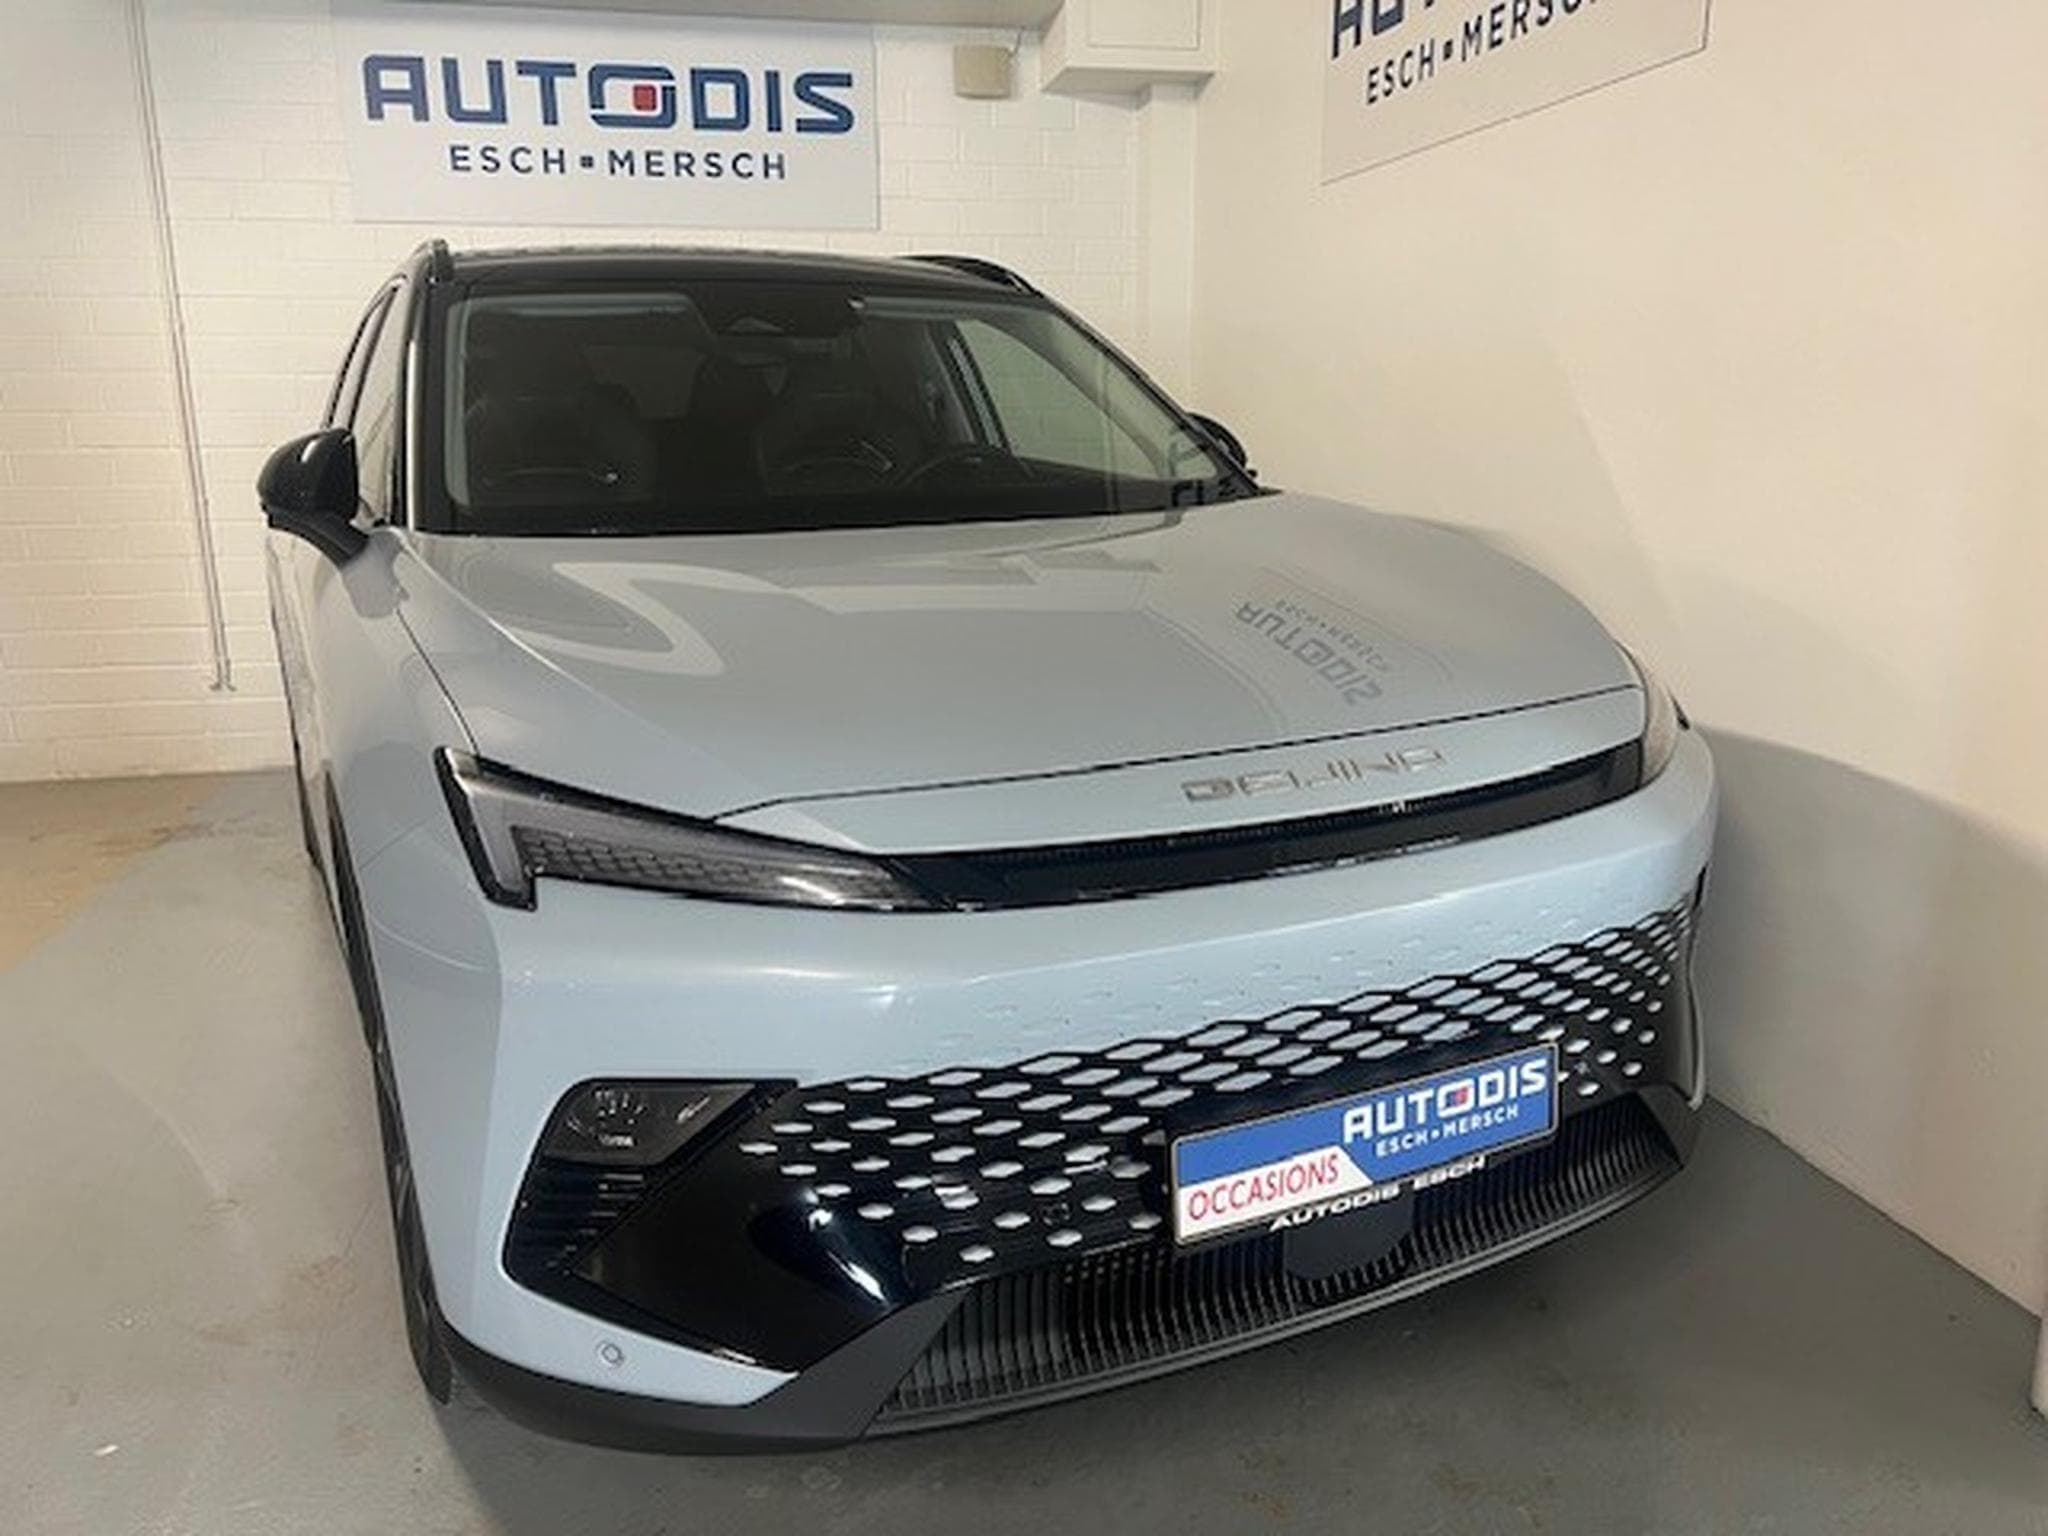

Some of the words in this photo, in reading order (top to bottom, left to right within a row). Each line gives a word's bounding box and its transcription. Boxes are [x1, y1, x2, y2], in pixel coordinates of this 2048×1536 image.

[1366, 38, 1435, 105] ESCH
[1461, 0, 1597, 62] MERS
[362, 54, 856, 135] AUTODIS
[448, 144, 567, 175] ESCH
[608, 149, 787, 180] MERSCH
[1343, 1059, 1548, 1143] AUTODIS
[1376, 1130, 1429, 1158] ESCH
[1444, 1104, 1519, 1139] MERSCH
[1187, 1153, 1340, 1221] OCCASIONS
[1269, 1183, 1400, 1231] AUTODIS
[1413, 1155, 1486, 1190] ESCH
